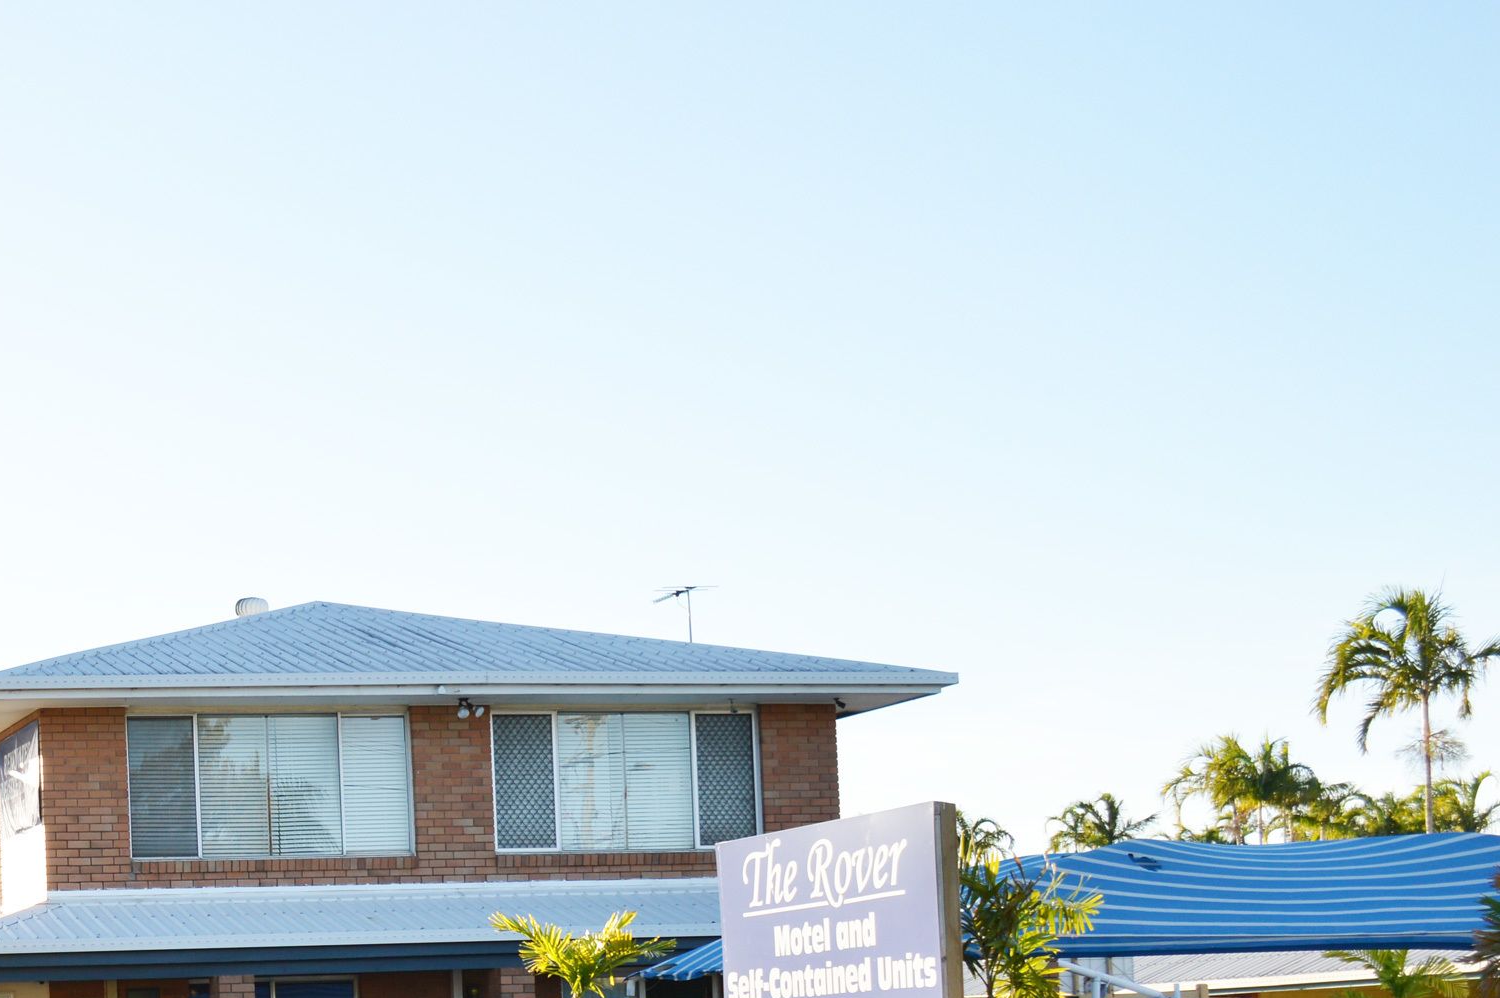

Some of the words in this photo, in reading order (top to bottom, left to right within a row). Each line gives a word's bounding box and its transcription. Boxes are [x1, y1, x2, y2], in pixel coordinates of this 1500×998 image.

[743, 837, 798, 908] The
[807, 838, 908, 908] Rover
[773, 917, 831, 957] Motel
[835, 911, 877, 950] and
[876, 952, 937, 990] Units
